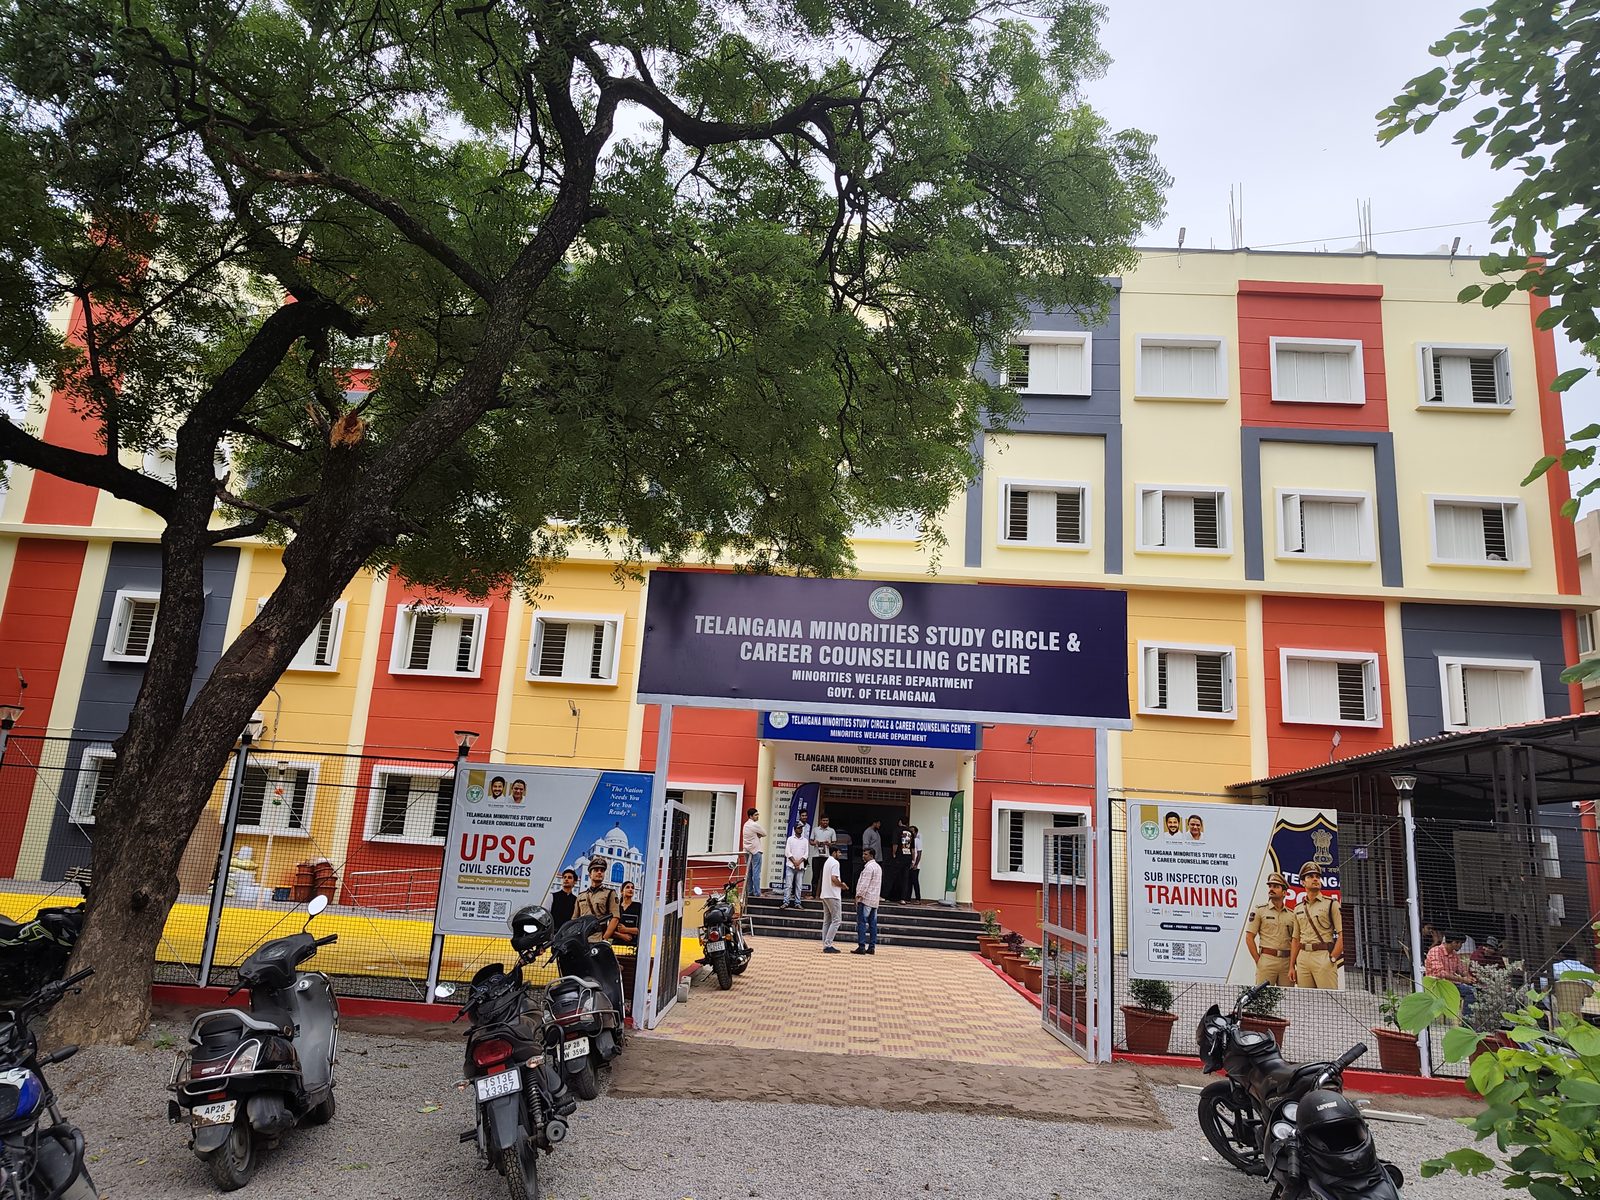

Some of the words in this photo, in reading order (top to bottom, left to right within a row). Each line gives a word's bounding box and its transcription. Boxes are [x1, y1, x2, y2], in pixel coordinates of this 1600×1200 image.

[695, 615, 803, 639] TELANGANA
[809, 620, 919, 644] MINORITIES
[925, 625, 985, 647] STUDY
[991, 629, 1060, 651] CIRCLE
[1066, 632, 1081, 653] &
[740, 641, 812, 663] CAREER
[818, 646, 950, 671] COUNSELLING
[956, 652, 1031, 675] CENTRE
[792, 670, 852, 683] MINORITIES
[855, 673, 902, 686] WELFARE
[905, 675, 974, 689] DEPARTMENT
[827, 687, 855, 699] GOVT.
[858, 688, 872, 700] OF
[874, 689, 936, 703] TELANGANA
[791, 715, 821, 726] TELANGANA
[822, 717, 852, 728] MINORITIES
[852, 719, 870, 729] STUDY
[870, 719, 889, 730] CIRCLE
[890, 721, 894, 730] &
[895, 720, 916, 731] CAREER
[916, 722, 950, 733] COUNSELING
[950, 723, 971, 734] CENTRE
[830, 729, 863, 739] MINORITIES
[863, 731, 889, 740] WELFARE
[890, 733, 927, 742] DEPARTMENT
[794, 753, 835, 763] TELANGANA
[836, 755, 877, 766] MINORITIES
[879, 757, 901, 767] STUDY
[902, 759, 928, 768] CIRCLE
[929, 760, 935, 769] &
[811, 763, 838, 773] CAREER
[840, 765, 888, 776] COUNSELLING
[889, 768, 917, 778] CENTRE
[623, 786, 644, 794] Nation
[466, 811, 493, 819] TELANGANA
[493, 813, 520, 821] MINORITIES
[608, 808, 630, 817] Ready?
[495, 820, 527, 828] COUNSELLING
[460, 832, 536, 865] UPSC
[459, 862, 483, 874] CIVIL
[485, 864, 532, 877] SERVICES
[1144, 871, 1163, 882] SUB
[1166, 872, 1219, 885] INSPECTOR
[1221, 875, 1238, 887] (SI)
[1144, 884, 1238, 909] TRAINING
[483, 1071, 514, 1088] TS13E
[204, 1104, 226, 1115] AP28
[212, 1112, 231, 1122] 255
